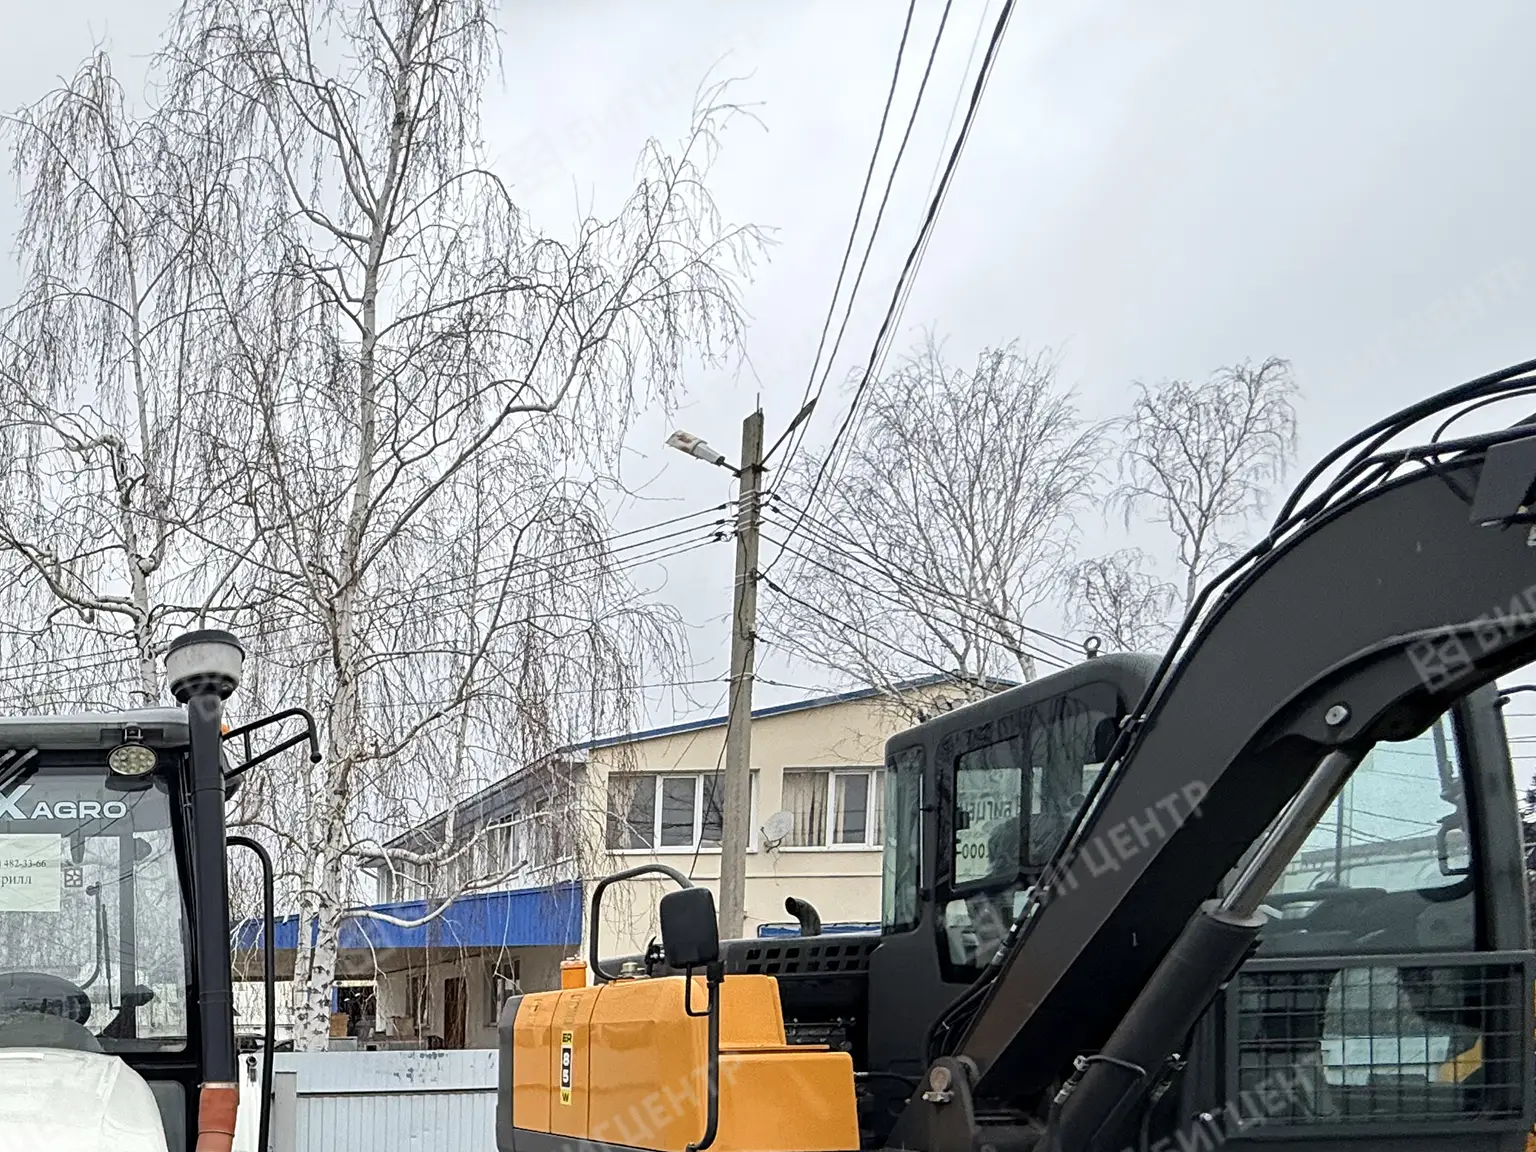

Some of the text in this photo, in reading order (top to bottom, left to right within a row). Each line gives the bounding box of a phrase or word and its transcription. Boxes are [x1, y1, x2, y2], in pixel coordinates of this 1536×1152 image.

[30, 800, 127, 820] AGRO
[562, 1033, 572, 1102] ER 85 W
